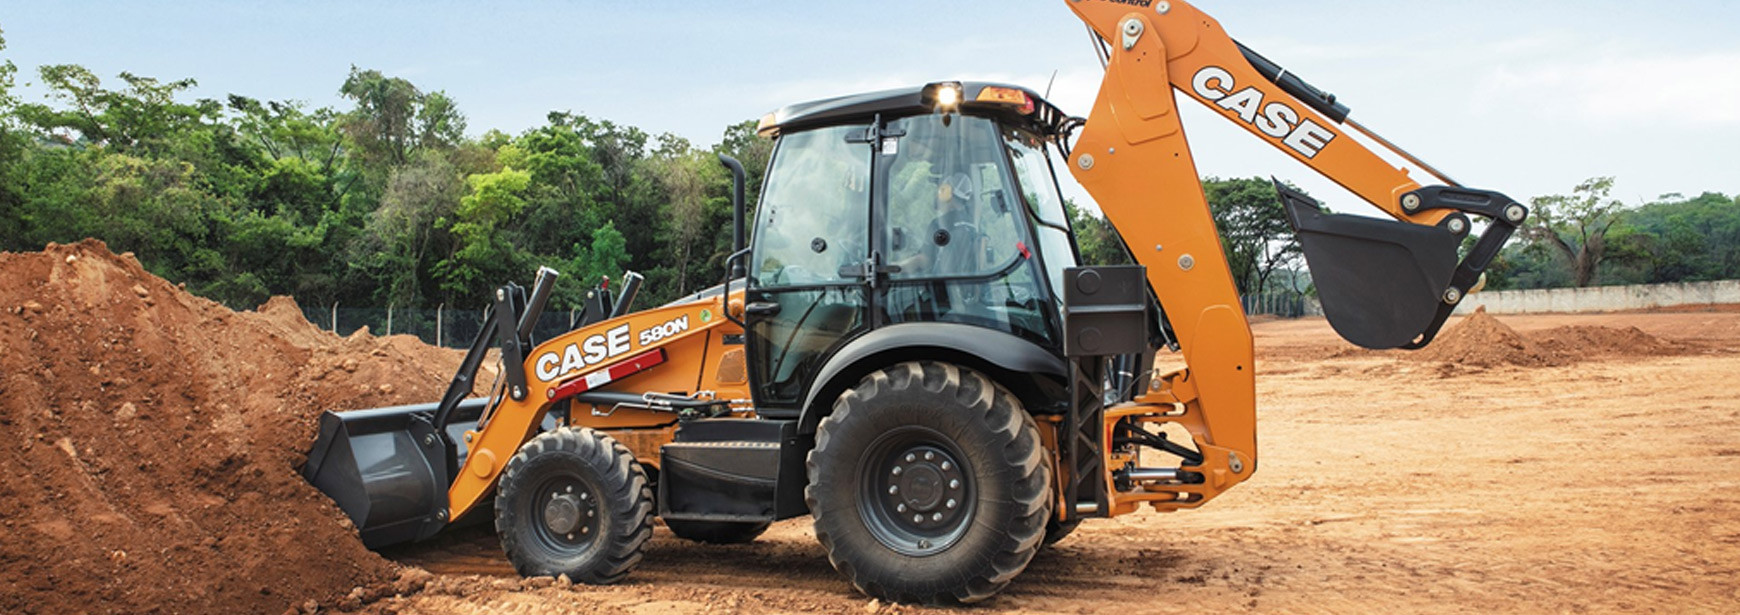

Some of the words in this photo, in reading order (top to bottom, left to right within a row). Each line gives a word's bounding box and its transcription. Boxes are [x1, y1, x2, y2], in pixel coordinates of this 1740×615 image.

[1192, 65, 1337, 159] CASE
[535, 323, 631, 382] CASE
[638, 314, 689, 346] 580N
